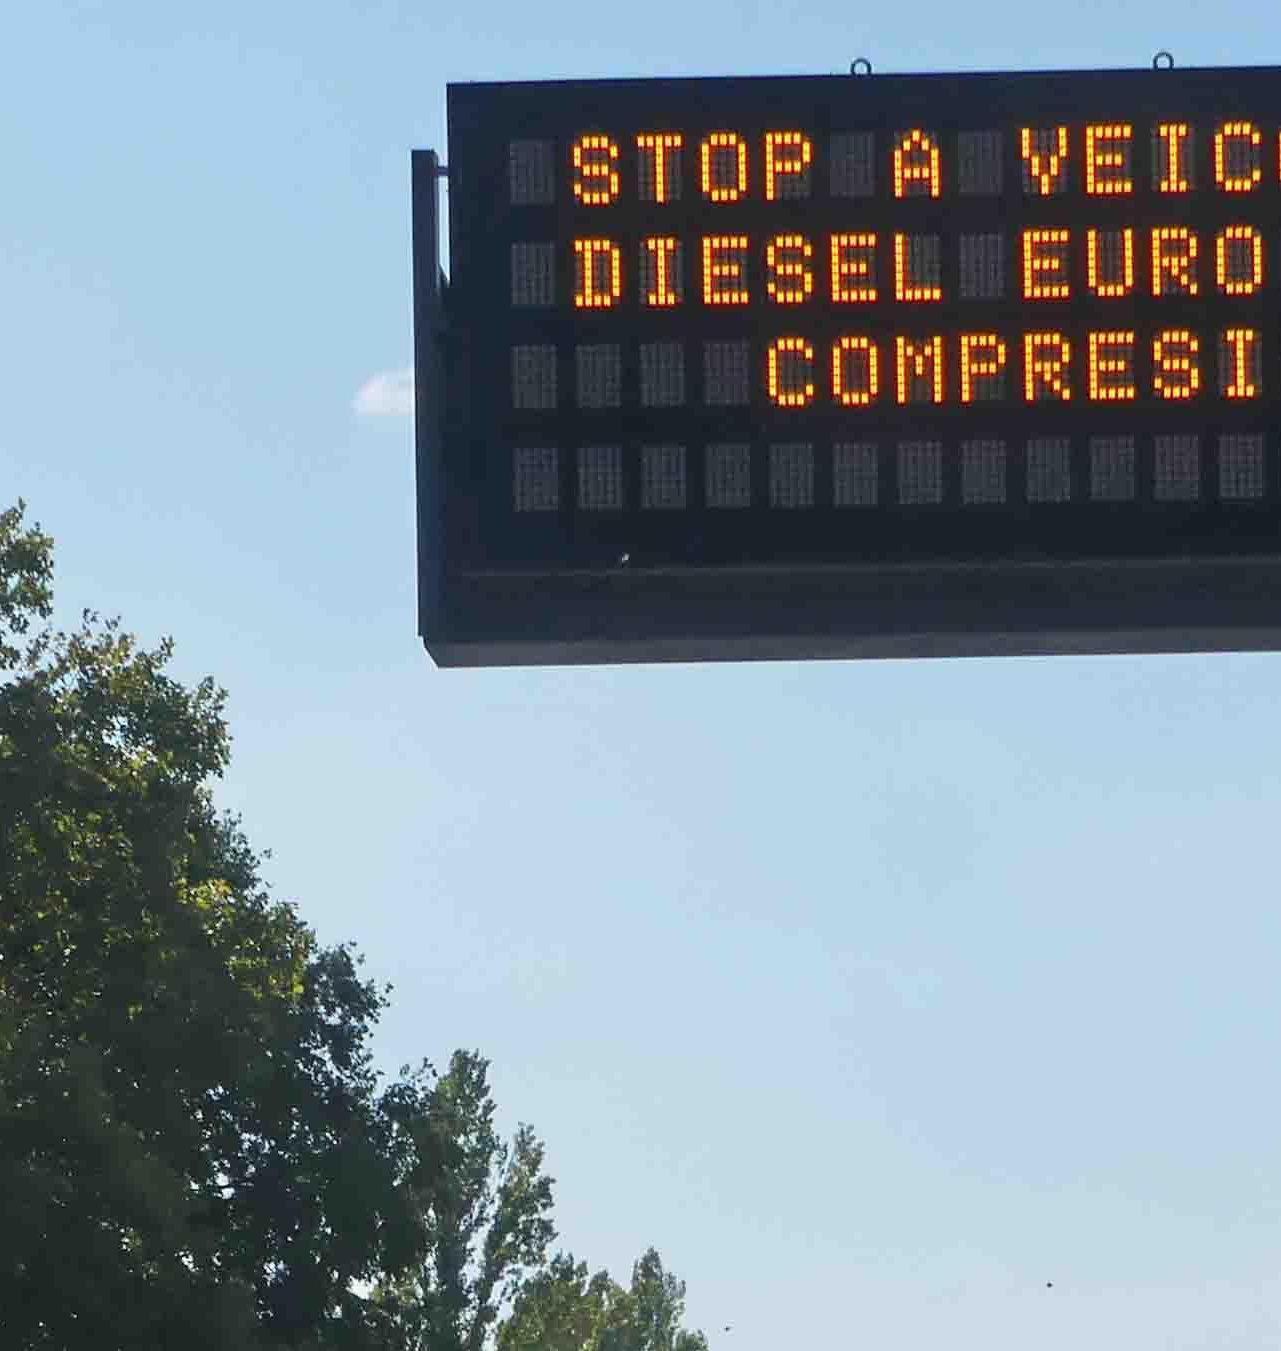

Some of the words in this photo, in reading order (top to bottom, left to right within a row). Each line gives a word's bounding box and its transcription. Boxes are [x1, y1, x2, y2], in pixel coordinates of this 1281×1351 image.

[573, 131, 811, 206] STOP
[893, 129, 940, 198] A
[574, 233, 942, 308] DIESEL
[1022, 226, 1263, 299] EURO
[766, 329, 1255, 407] COMPRESI
